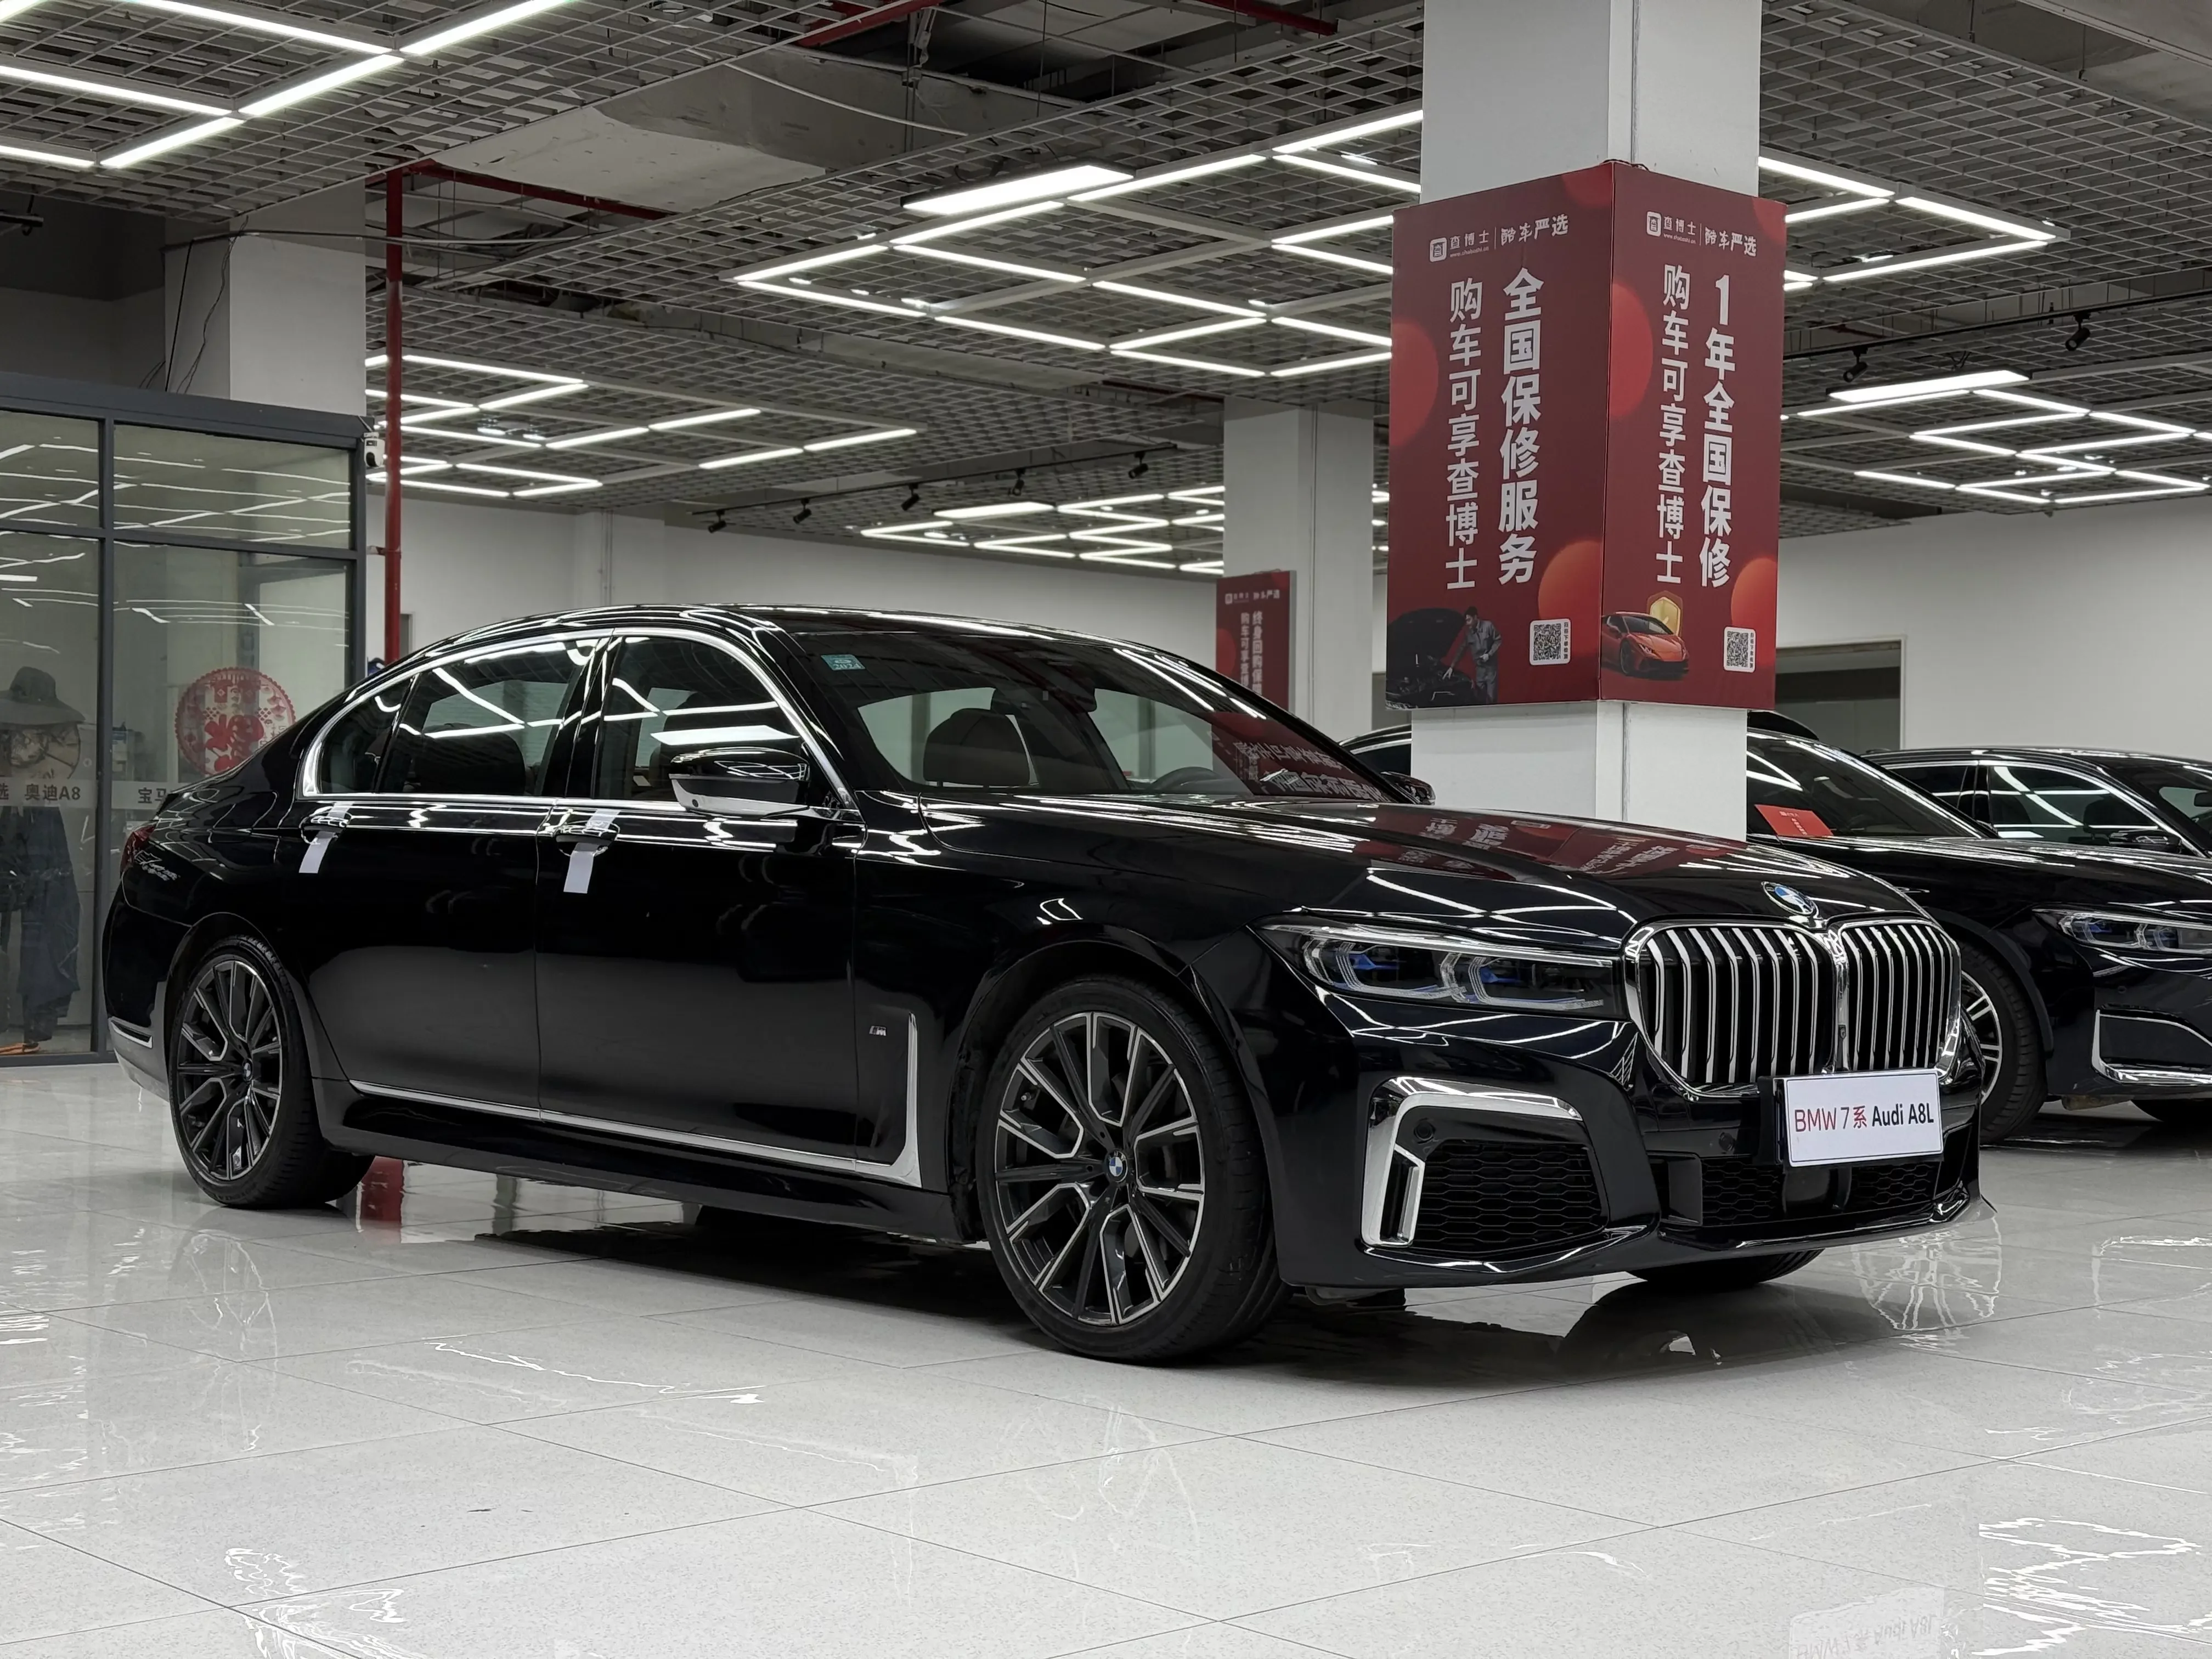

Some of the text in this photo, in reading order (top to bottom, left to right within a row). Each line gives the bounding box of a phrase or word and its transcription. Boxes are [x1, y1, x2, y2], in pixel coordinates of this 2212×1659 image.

[1449, 229, 1489, 250] 查博士
[1663, 216, 1696, 236] 查博士
[1446, 277, 1482, 590] 购车可享查博士
[1498, 267, 1544, 585] 全国保修服务
[1656, 264, 1690, 584] 购车可享查博士
[1699, 274, 1735, 588] 1年全国保修
[25, 783, 81, 801] 奥迪A8
[1795, 1103, 1934, 1132] BMW 7系 Audi A8L
